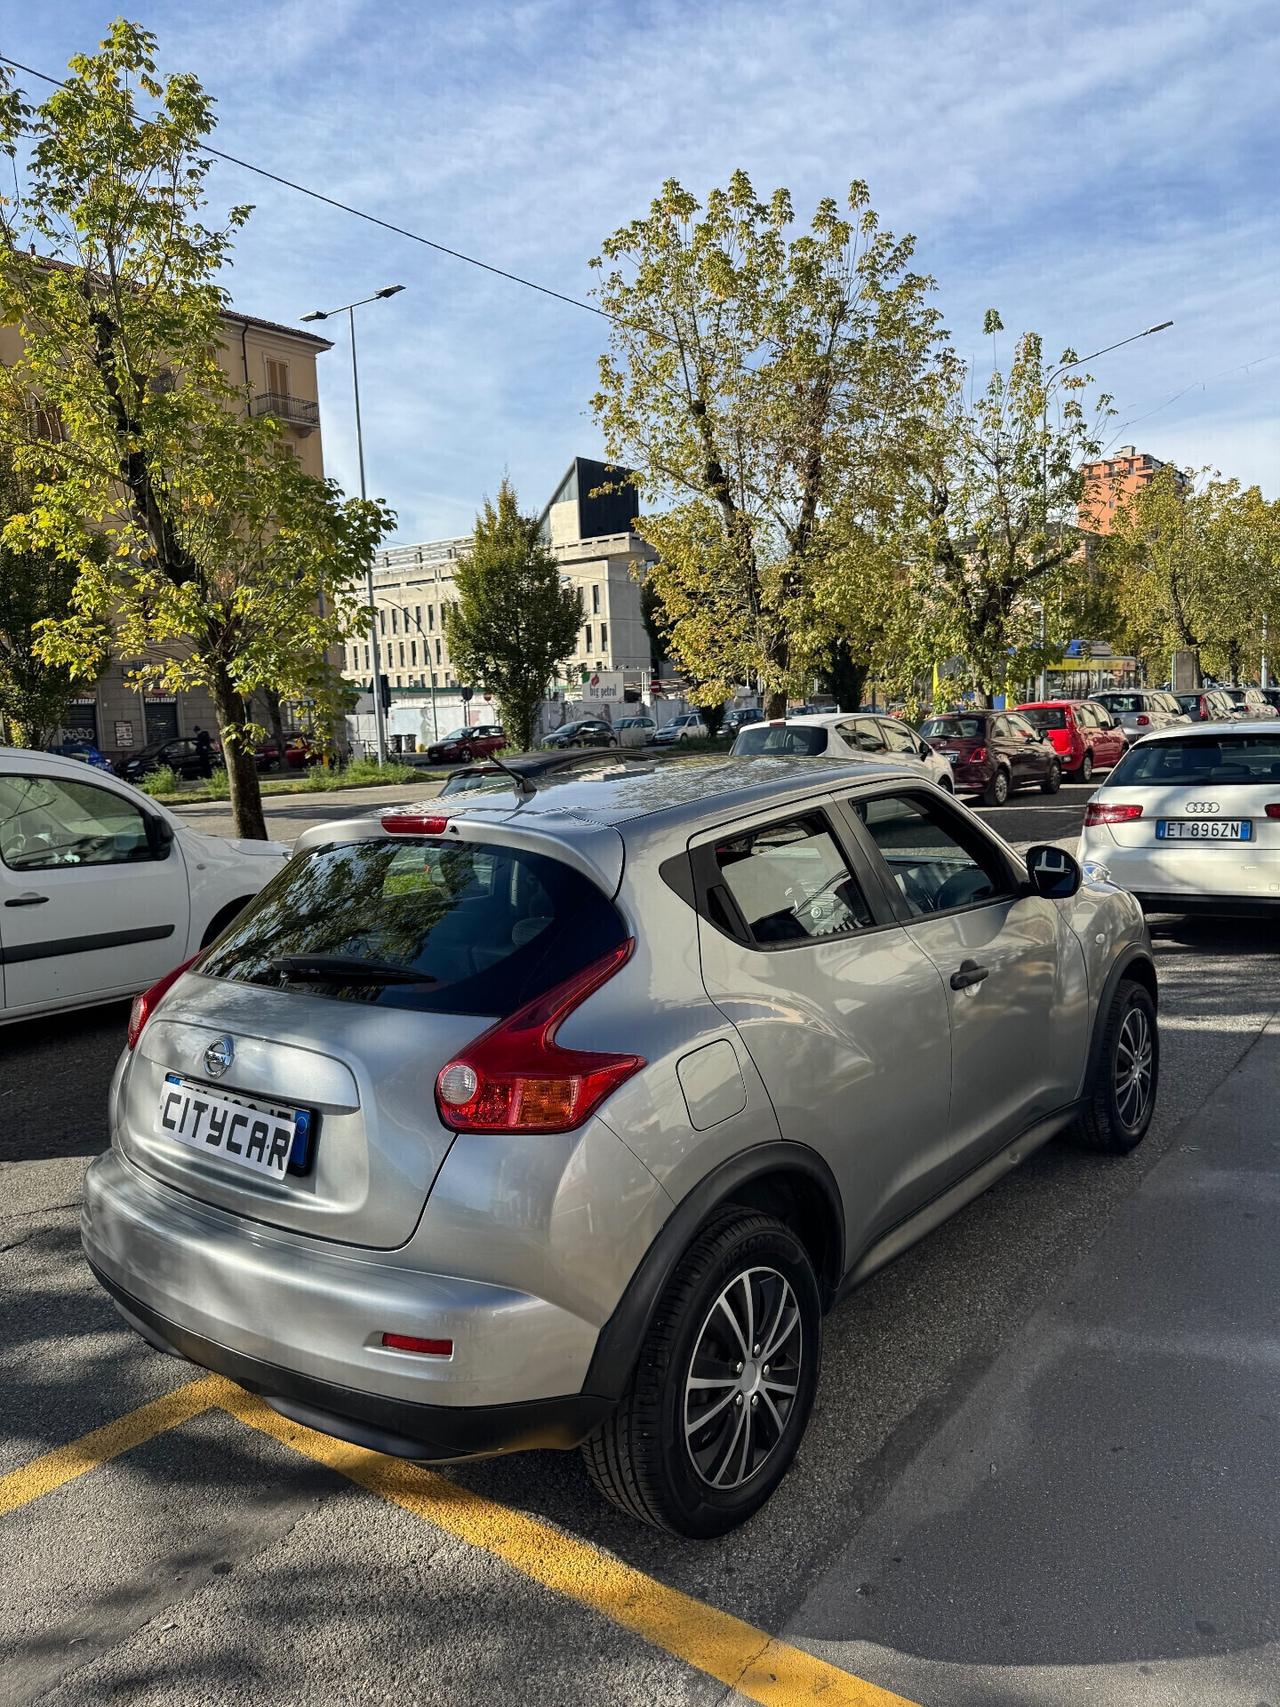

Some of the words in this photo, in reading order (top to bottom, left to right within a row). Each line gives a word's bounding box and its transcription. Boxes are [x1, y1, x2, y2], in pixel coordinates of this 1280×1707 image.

[589, 683, 599, 699] big
[600, 683, 617, 699] petrol
[1167, 823, 1185, 836] ET
[1191, 823, 1239, 837] 896ZN
[162, 1092, 291, 1171] CITYCAR
